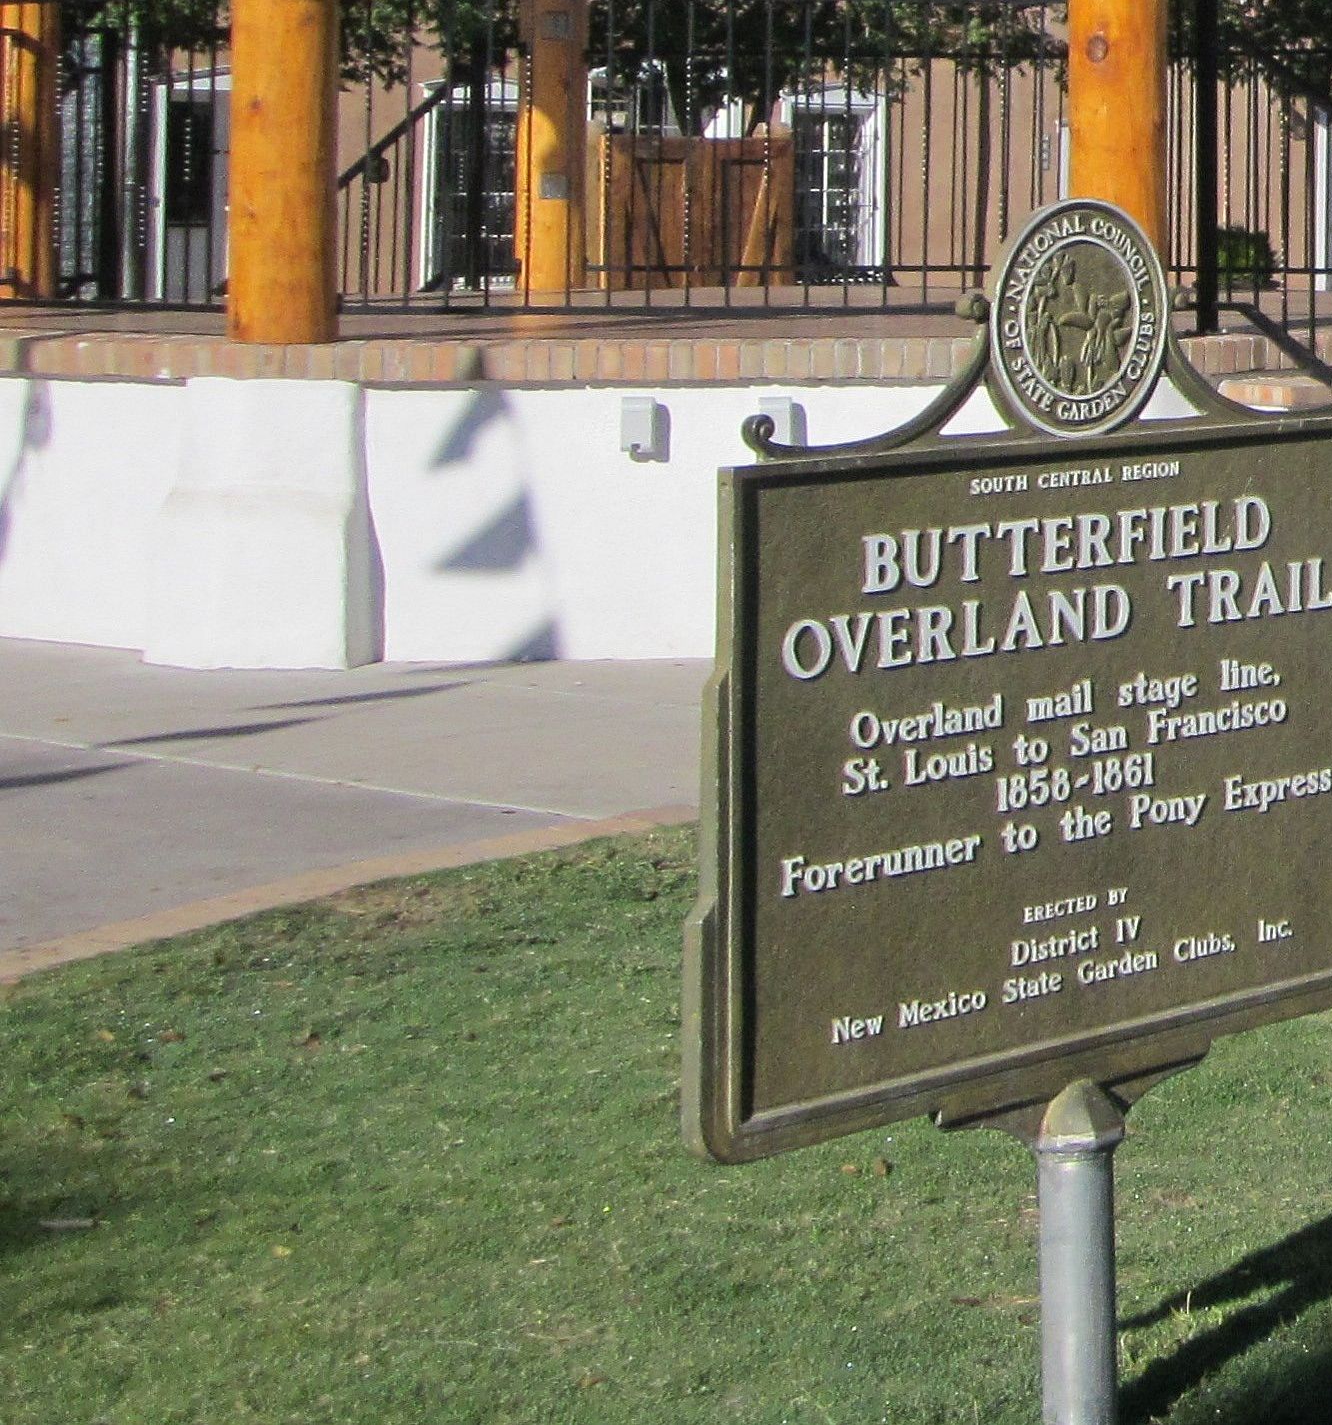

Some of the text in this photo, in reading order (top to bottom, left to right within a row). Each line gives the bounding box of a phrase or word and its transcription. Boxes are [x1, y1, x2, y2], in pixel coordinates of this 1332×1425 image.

[1006, 215, 1150, 300] NATIONAL COUNCIL
[1004, 312, 1155, 420] OF STATE GARDEN CLUBS
[970, 461, 1180, 495] SOUTH CENTRAL REGION
[861, 495, 1272, 595] BUTTERFIELD
[781, 583, 1132, 680] OVERLAND
[843, 698, 1287, 795] St. Louis to San Francisco
[850, 658, 1281, 749] Overland mail stage line,
[996, 753, 1155, 814] 1858-1861
[780, 768, 1332, 897] Forerunner to the Pony Express
[1010, 916, 1141, 967] District IV
[1023, 887, 1129, 923] ERECTED BY
[830, 1013, 882, 1045] New
[899, 989, 987, 1028] Mexico
[1002, 972, 1062, 1005] State
[1077, 948, 1158, 986] Garden
[1257, 918, 1294, 943] Inc.
